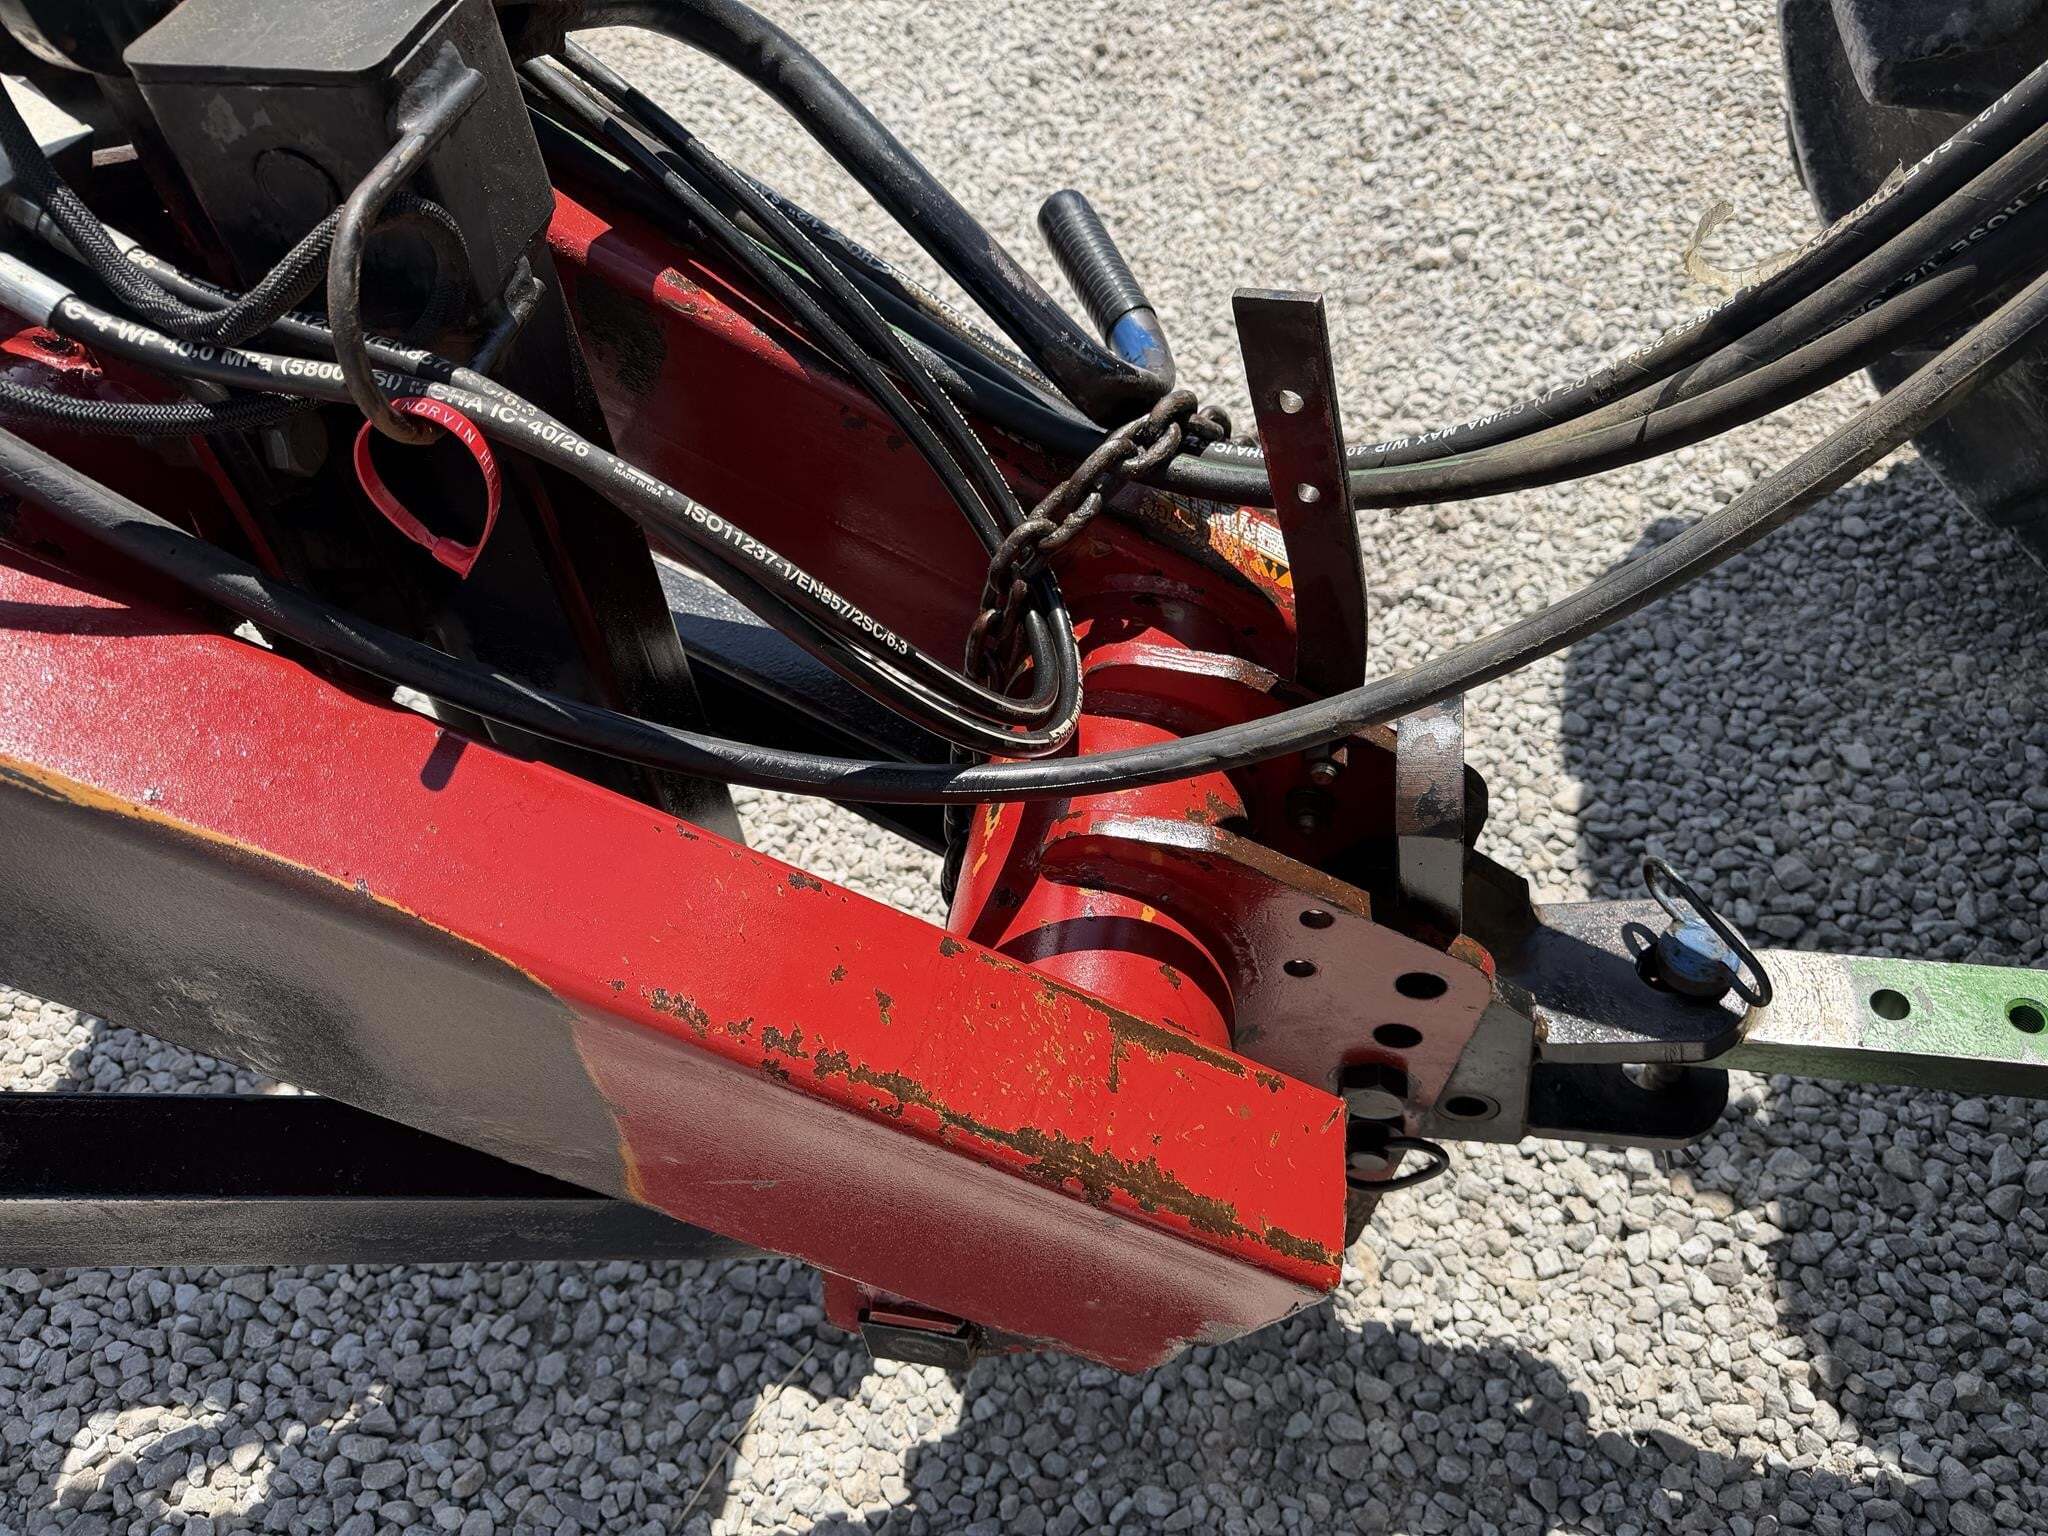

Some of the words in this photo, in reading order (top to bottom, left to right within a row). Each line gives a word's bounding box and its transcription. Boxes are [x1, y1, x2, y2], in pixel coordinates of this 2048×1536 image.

[1950, 199, 2028, 250] HOSE
[116, 320, 161, 346] WP
[220, 350, 273, 372] MPa
[372, 369, 402, 392] SI)
[490, 403, 591, 458] IC-40/26
[400, 398, 476, 444] NORVIN
[1416, 425, 1459, 445] MAX
[1466, 404, 1525, 431] CHINA
[613, 466, 637, 483] MADE
[644, 483, 663, 497] USA
